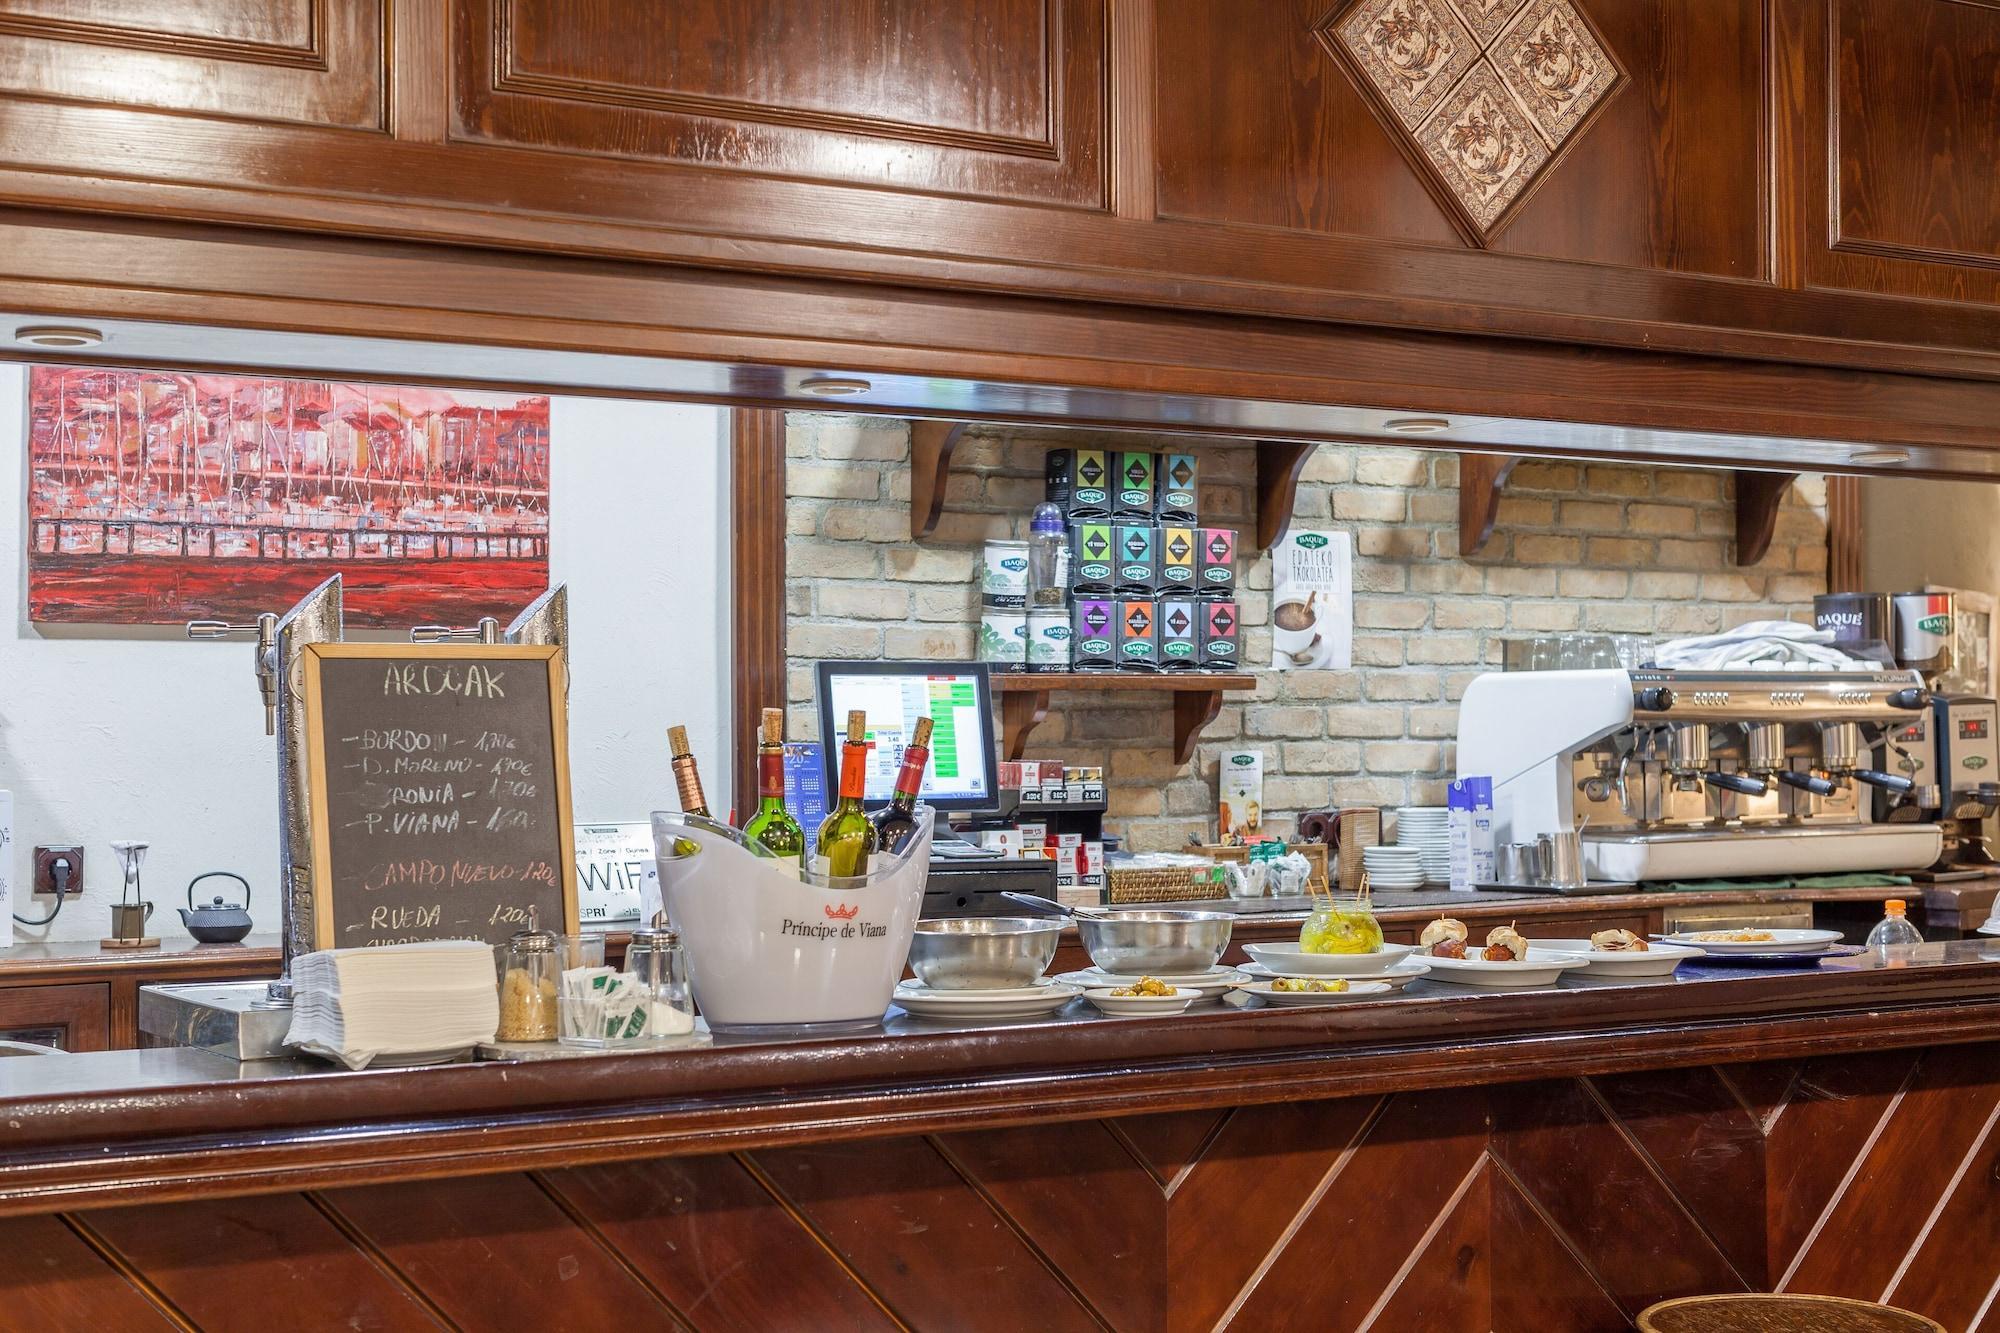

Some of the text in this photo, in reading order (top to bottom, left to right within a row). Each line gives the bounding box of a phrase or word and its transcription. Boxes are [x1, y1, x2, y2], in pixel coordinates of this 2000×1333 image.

[1292, 550, 1332, 566] EDATEKO
[371, 904, 441, 931] RUEDA
[781, 918, 887, 941] Príncipe de Viana
